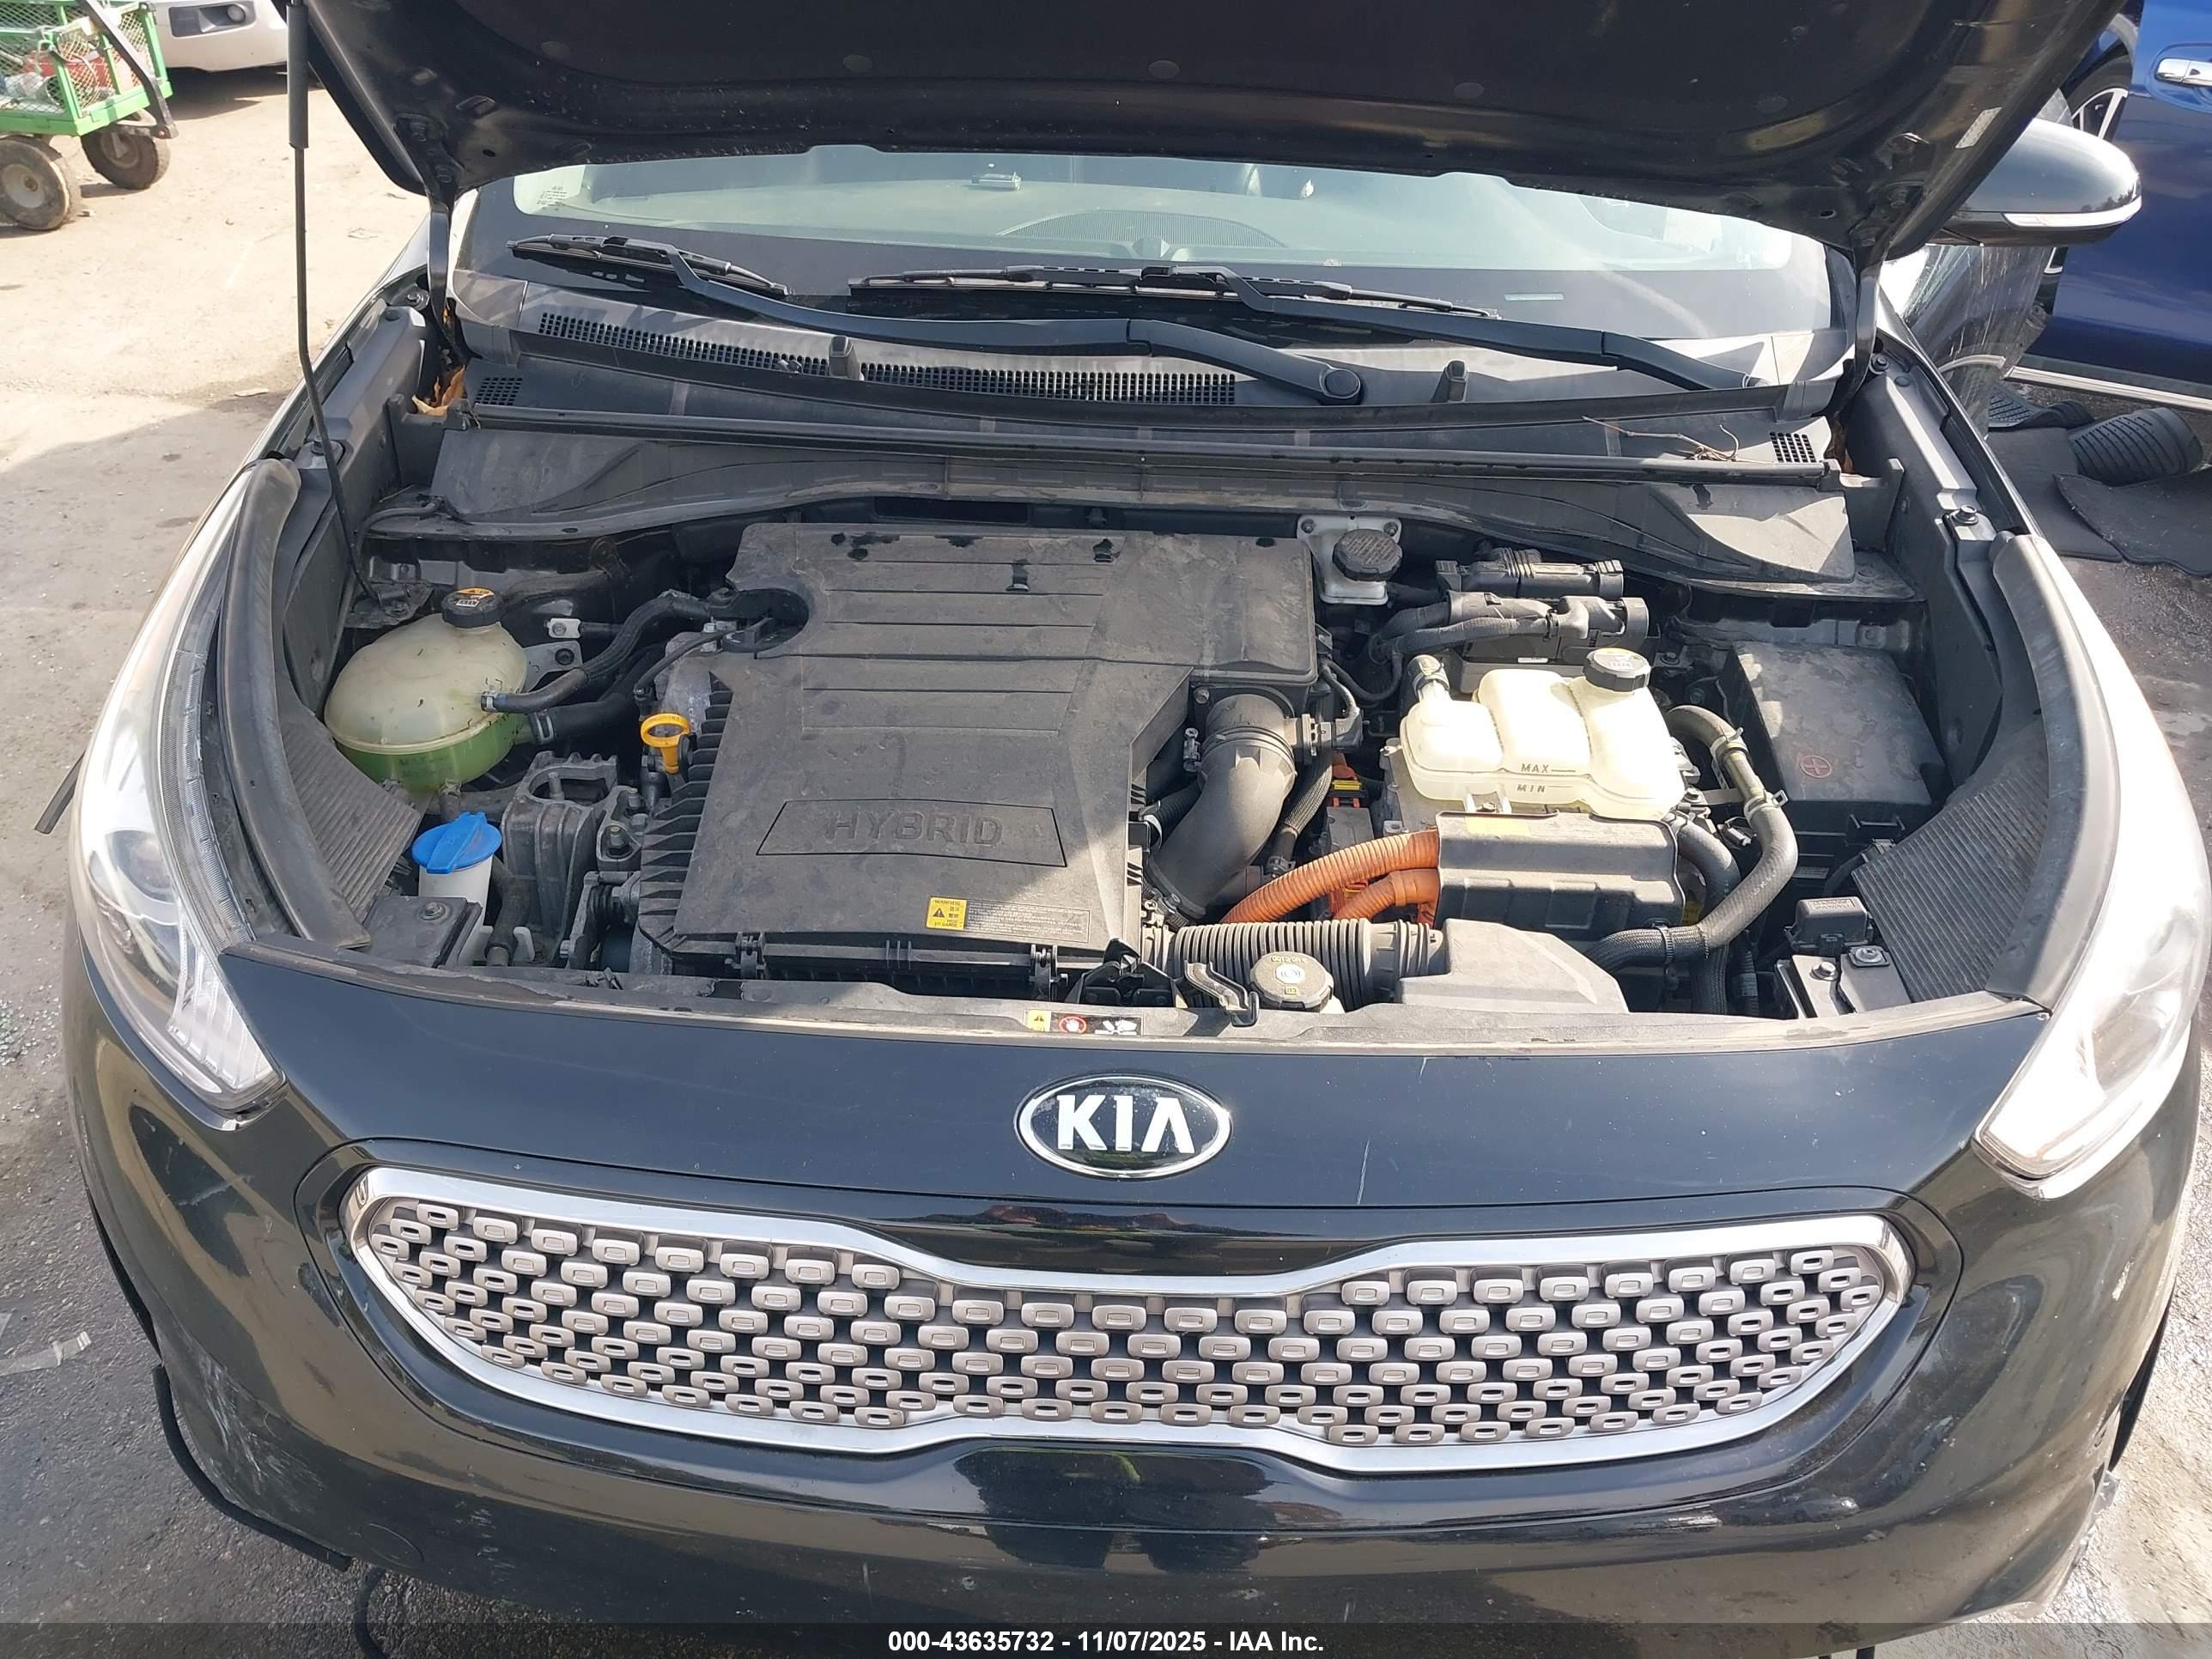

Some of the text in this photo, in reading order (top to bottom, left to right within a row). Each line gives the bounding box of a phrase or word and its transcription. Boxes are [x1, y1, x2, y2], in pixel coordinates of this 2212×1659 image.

[1521, 763, 1549, 773] MAX
[1516, 783, 1546, 793] MIN
[824, 810, 1004, 847] HYBRID
[1057, 1095, 1195, 1154] KIA
